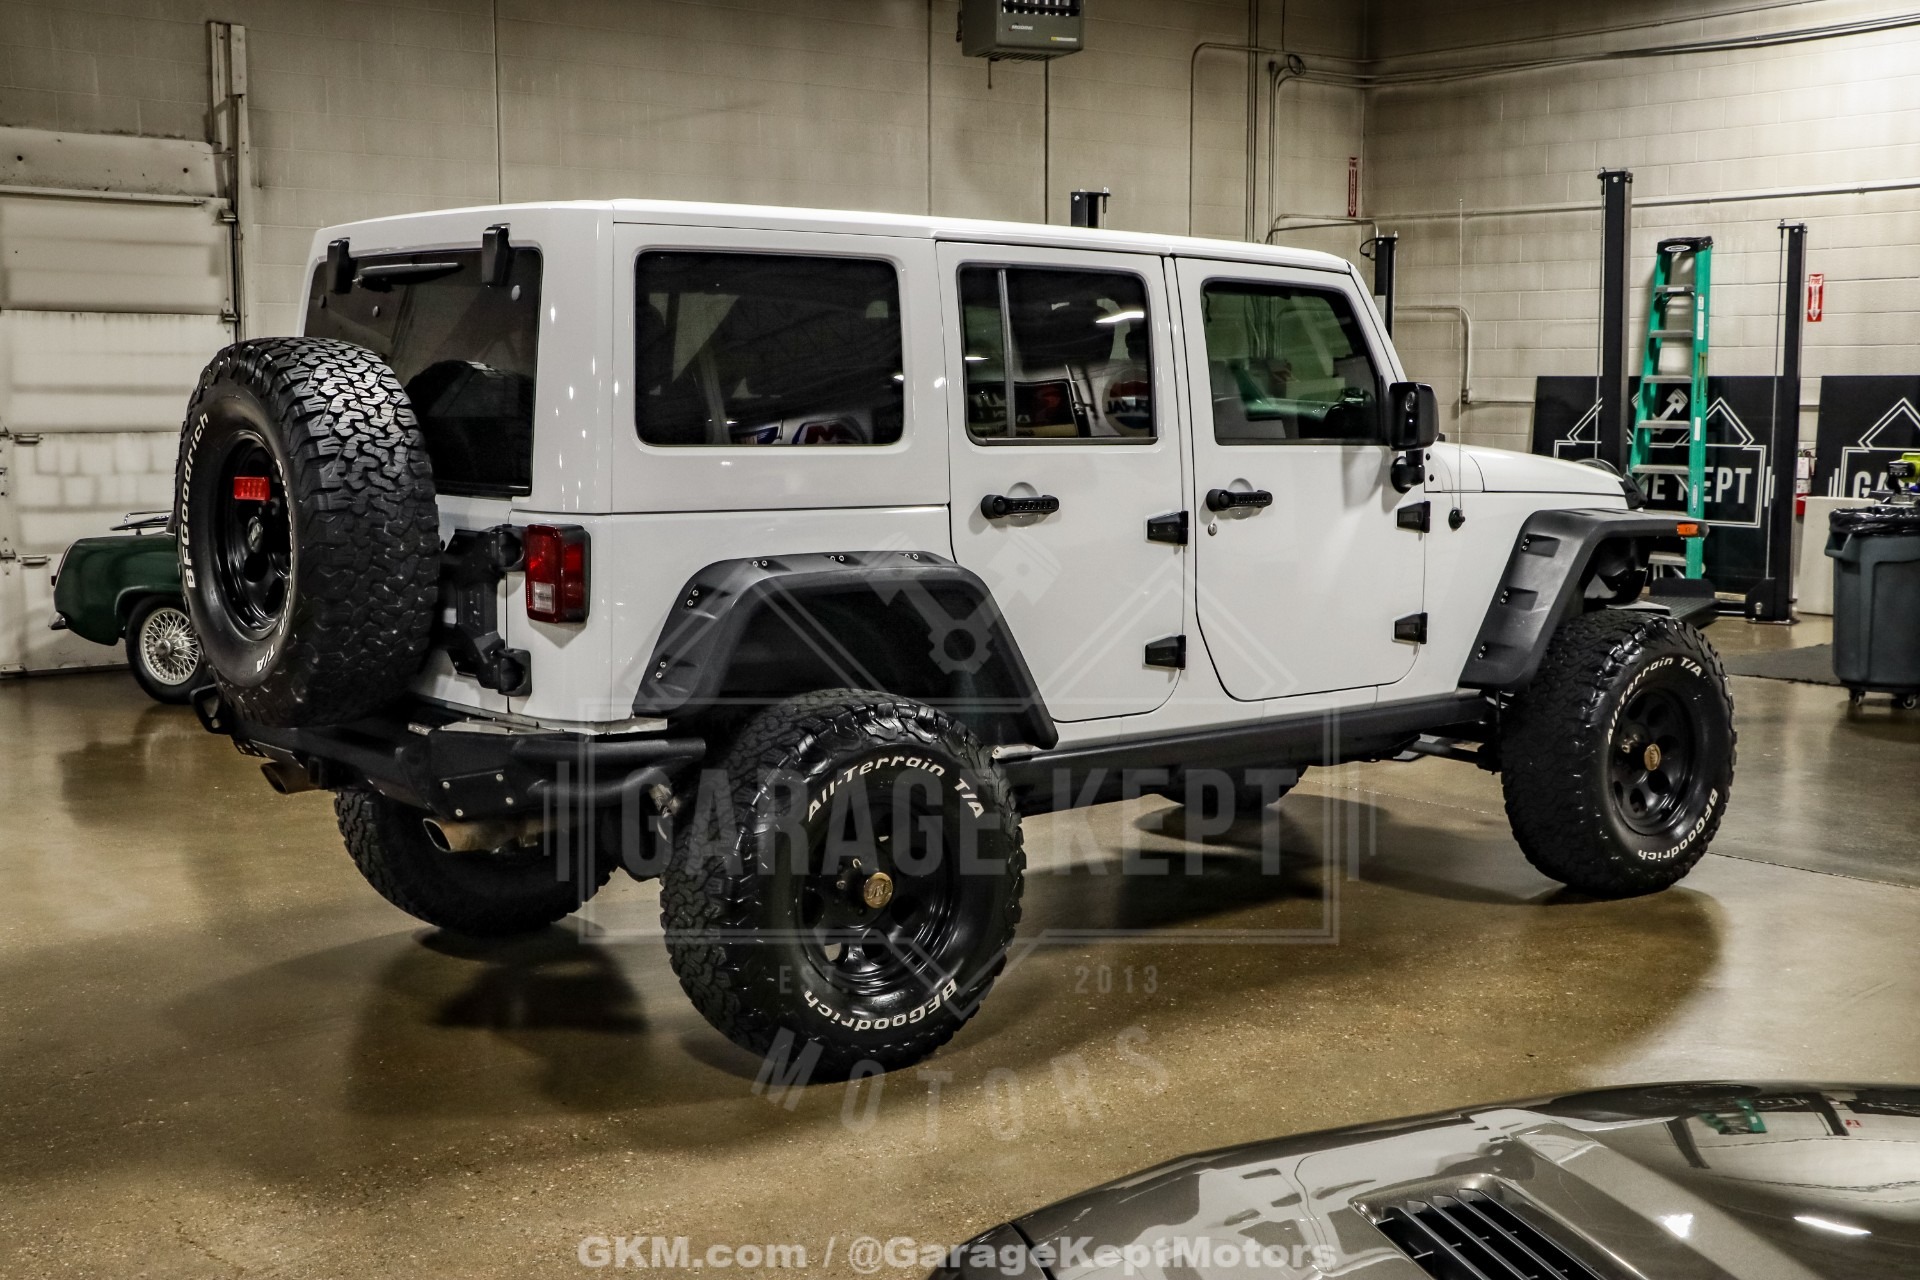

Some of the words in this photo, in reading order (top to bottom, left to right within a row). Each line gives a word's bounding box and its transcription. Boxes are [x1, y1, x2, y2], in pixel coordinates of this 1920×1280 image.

[182, 411, 209, 588] BFGoodrich
[1607, 657, 1674, 744] All-Terrain
[1680, 656, 1702, 677] T/A
[808, 755, 946, 822] All-Terrain
[954, 778, 985, 818] T/A
[1637, 788, 1719, 861] BFGoodrich
[803, 978, 958, 1032] BFGoodrich
